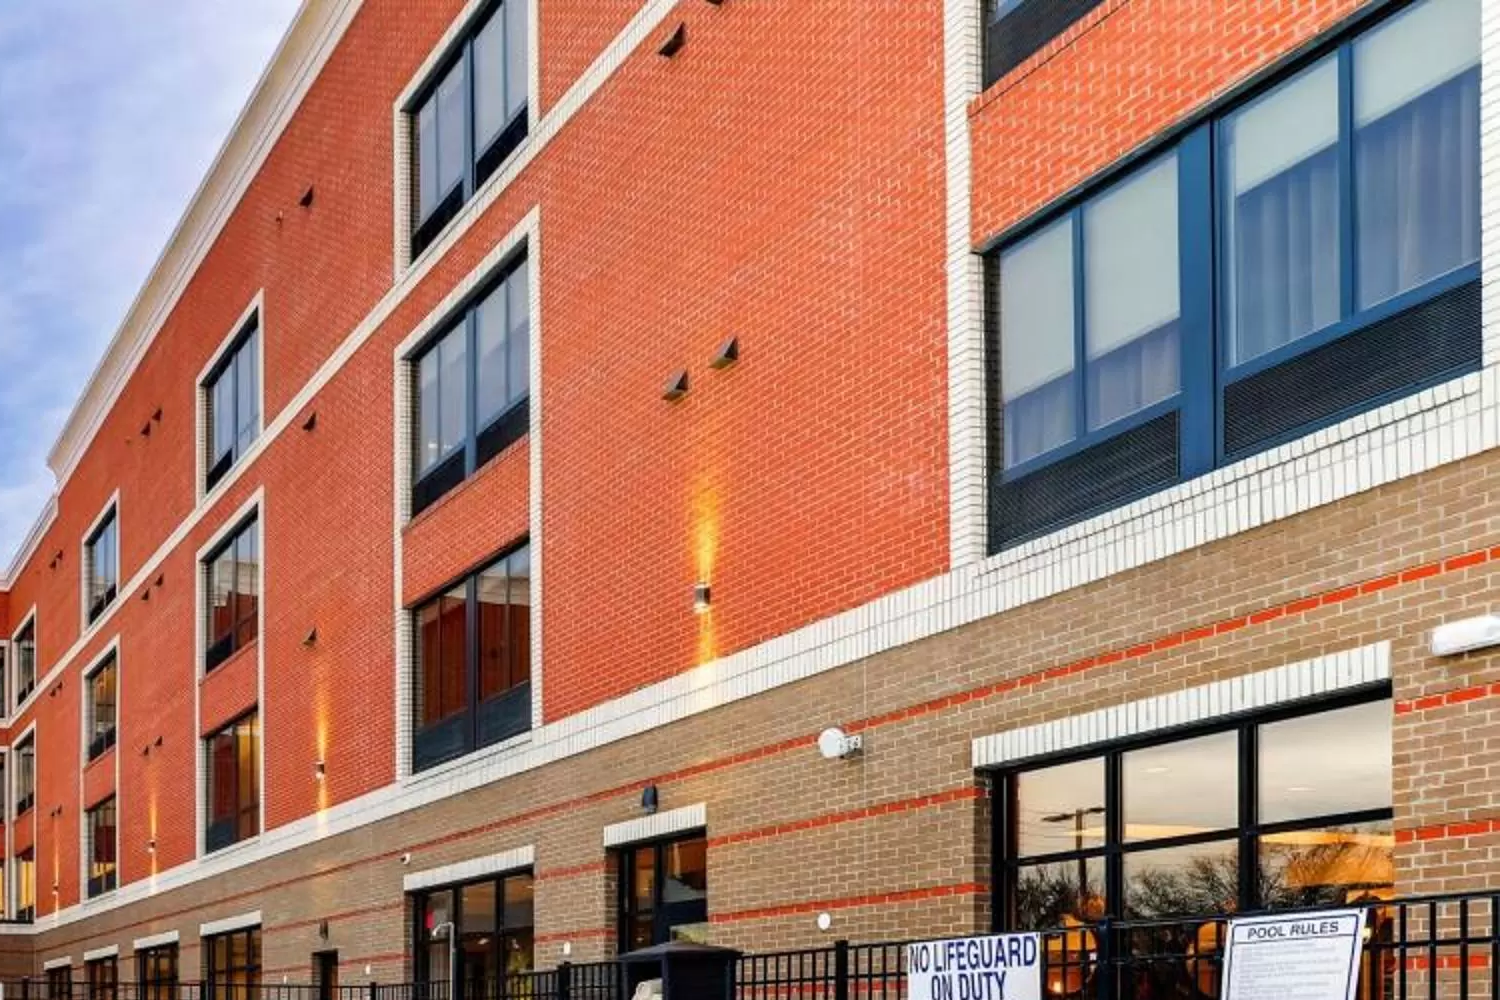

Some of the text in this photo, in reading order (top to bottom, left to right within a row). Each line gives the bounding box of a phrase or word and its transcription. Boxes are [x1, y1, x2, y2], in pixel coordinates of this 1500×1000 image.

[1247, 920, 1339, 939] POOL RULES
[909, 935, 1037, 974] NO LIFEGUARD
